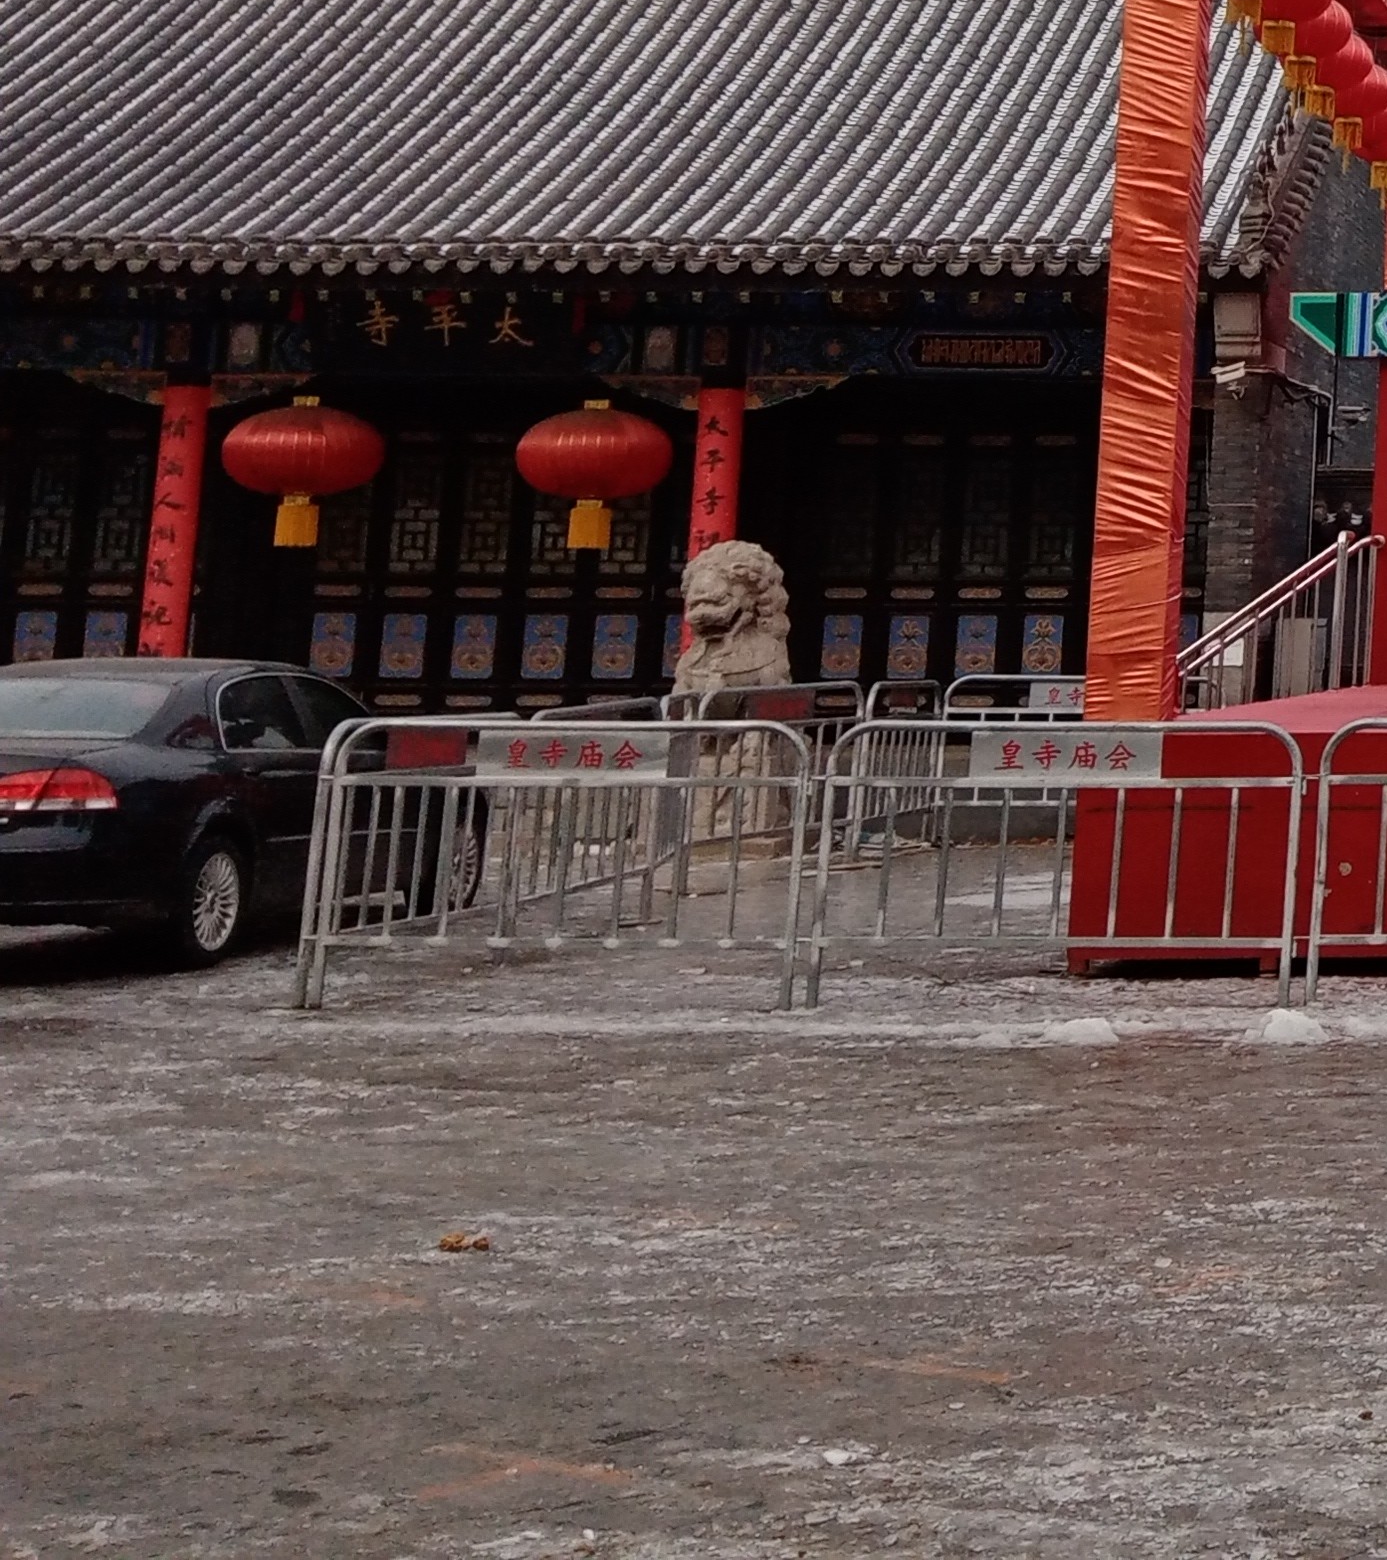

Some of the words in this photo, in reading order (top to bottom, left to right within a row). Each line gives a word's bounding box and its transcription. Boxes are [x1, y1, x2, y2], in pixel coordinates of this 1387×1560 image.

[507, 739, 642, 769] 皇寺庙会
[994, 739, 1136, 770] 皇寺庙会
